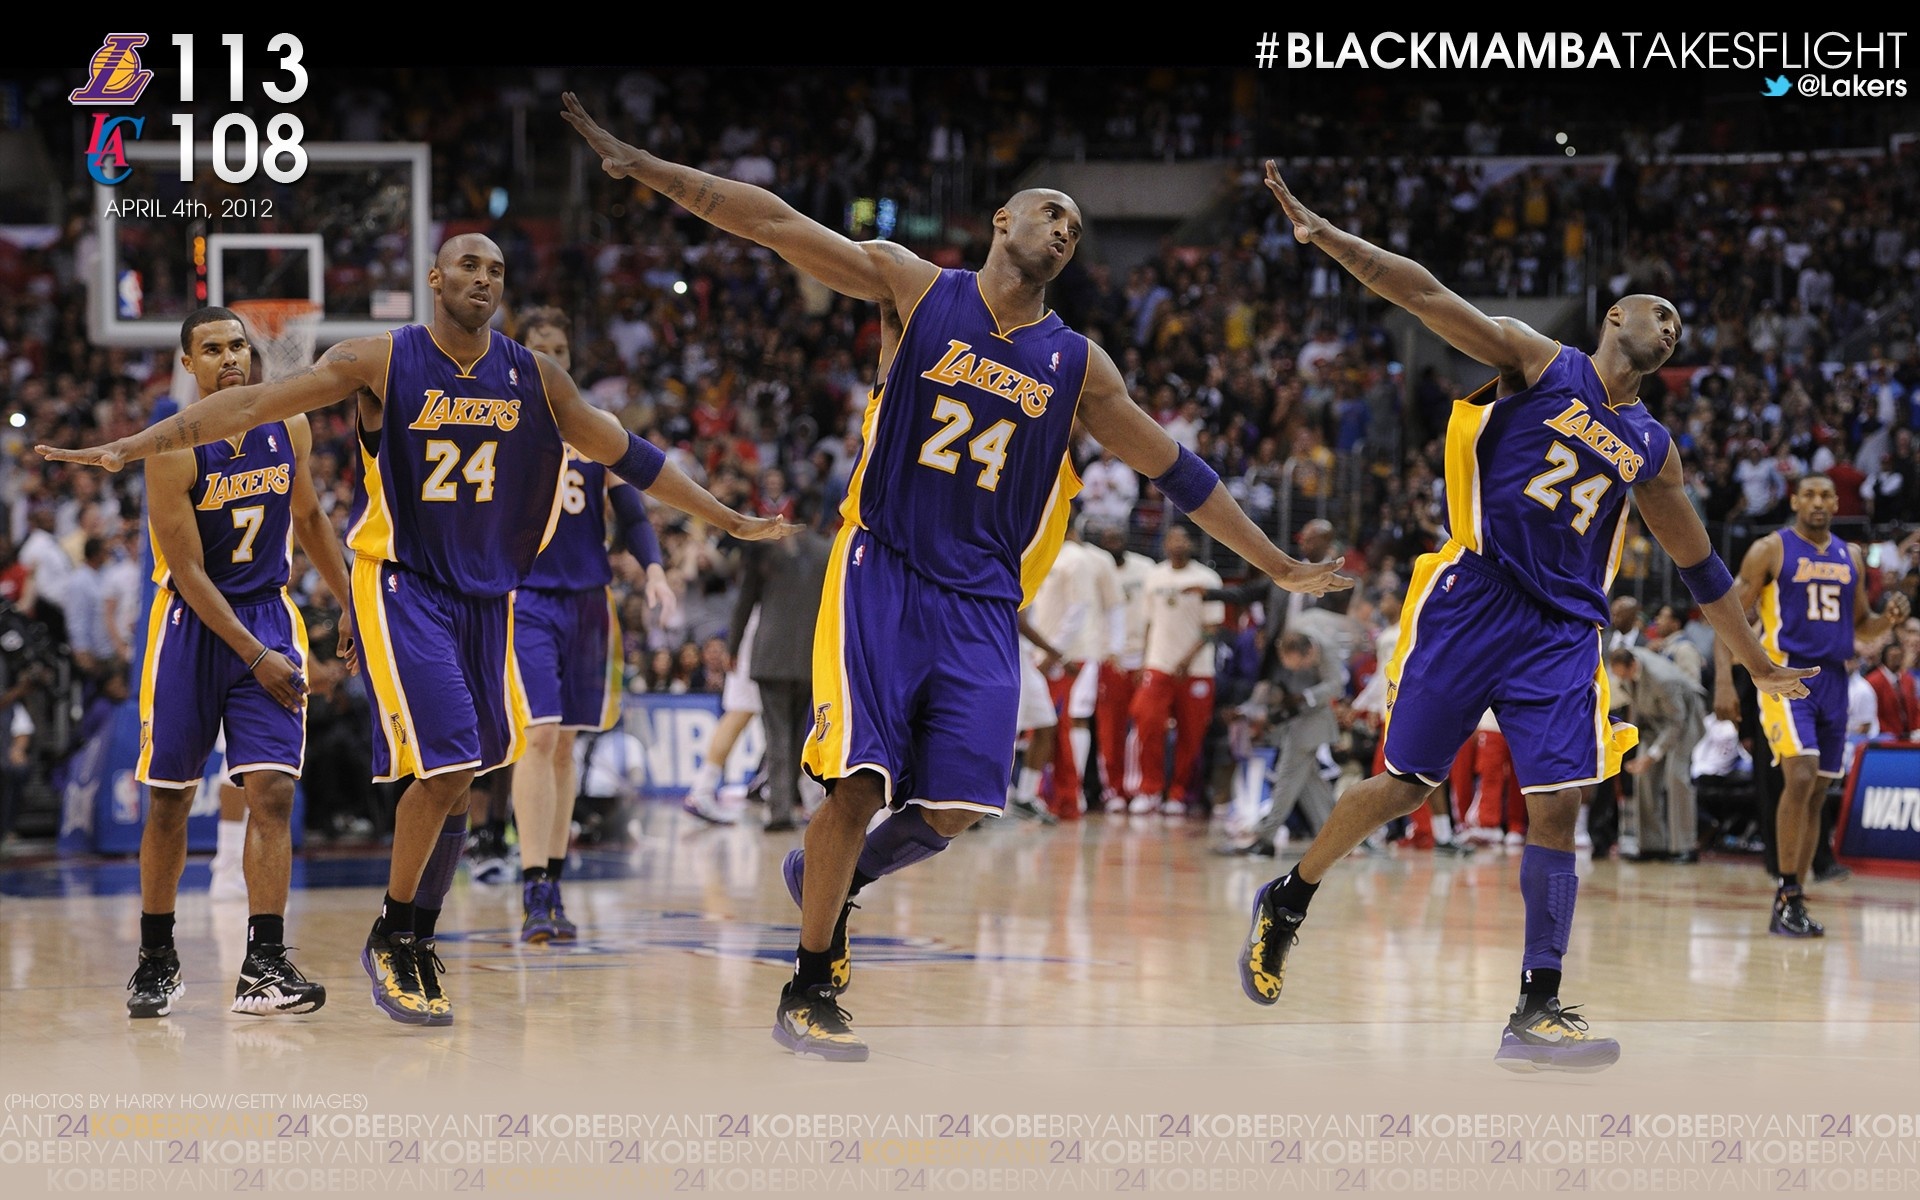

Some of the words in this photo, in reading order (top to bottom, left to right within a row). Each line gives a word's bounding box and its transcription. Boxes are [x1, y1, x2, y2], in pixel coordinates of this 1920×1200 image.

[408, 389, 522, 432] LAKERS
[921, 338, 1055, 419] LAKERS
[421, 439, 498, 503] 24
[917, 394, 1018, 492] 24
[1542, 397, 1645, 483] LAKERS
[196, 462, 291, 512] LAKERS
[1523, 439, 1613, 536] 24
[231, 504, 265, 564] 7
[1806, 582, 1842, 622] 15
